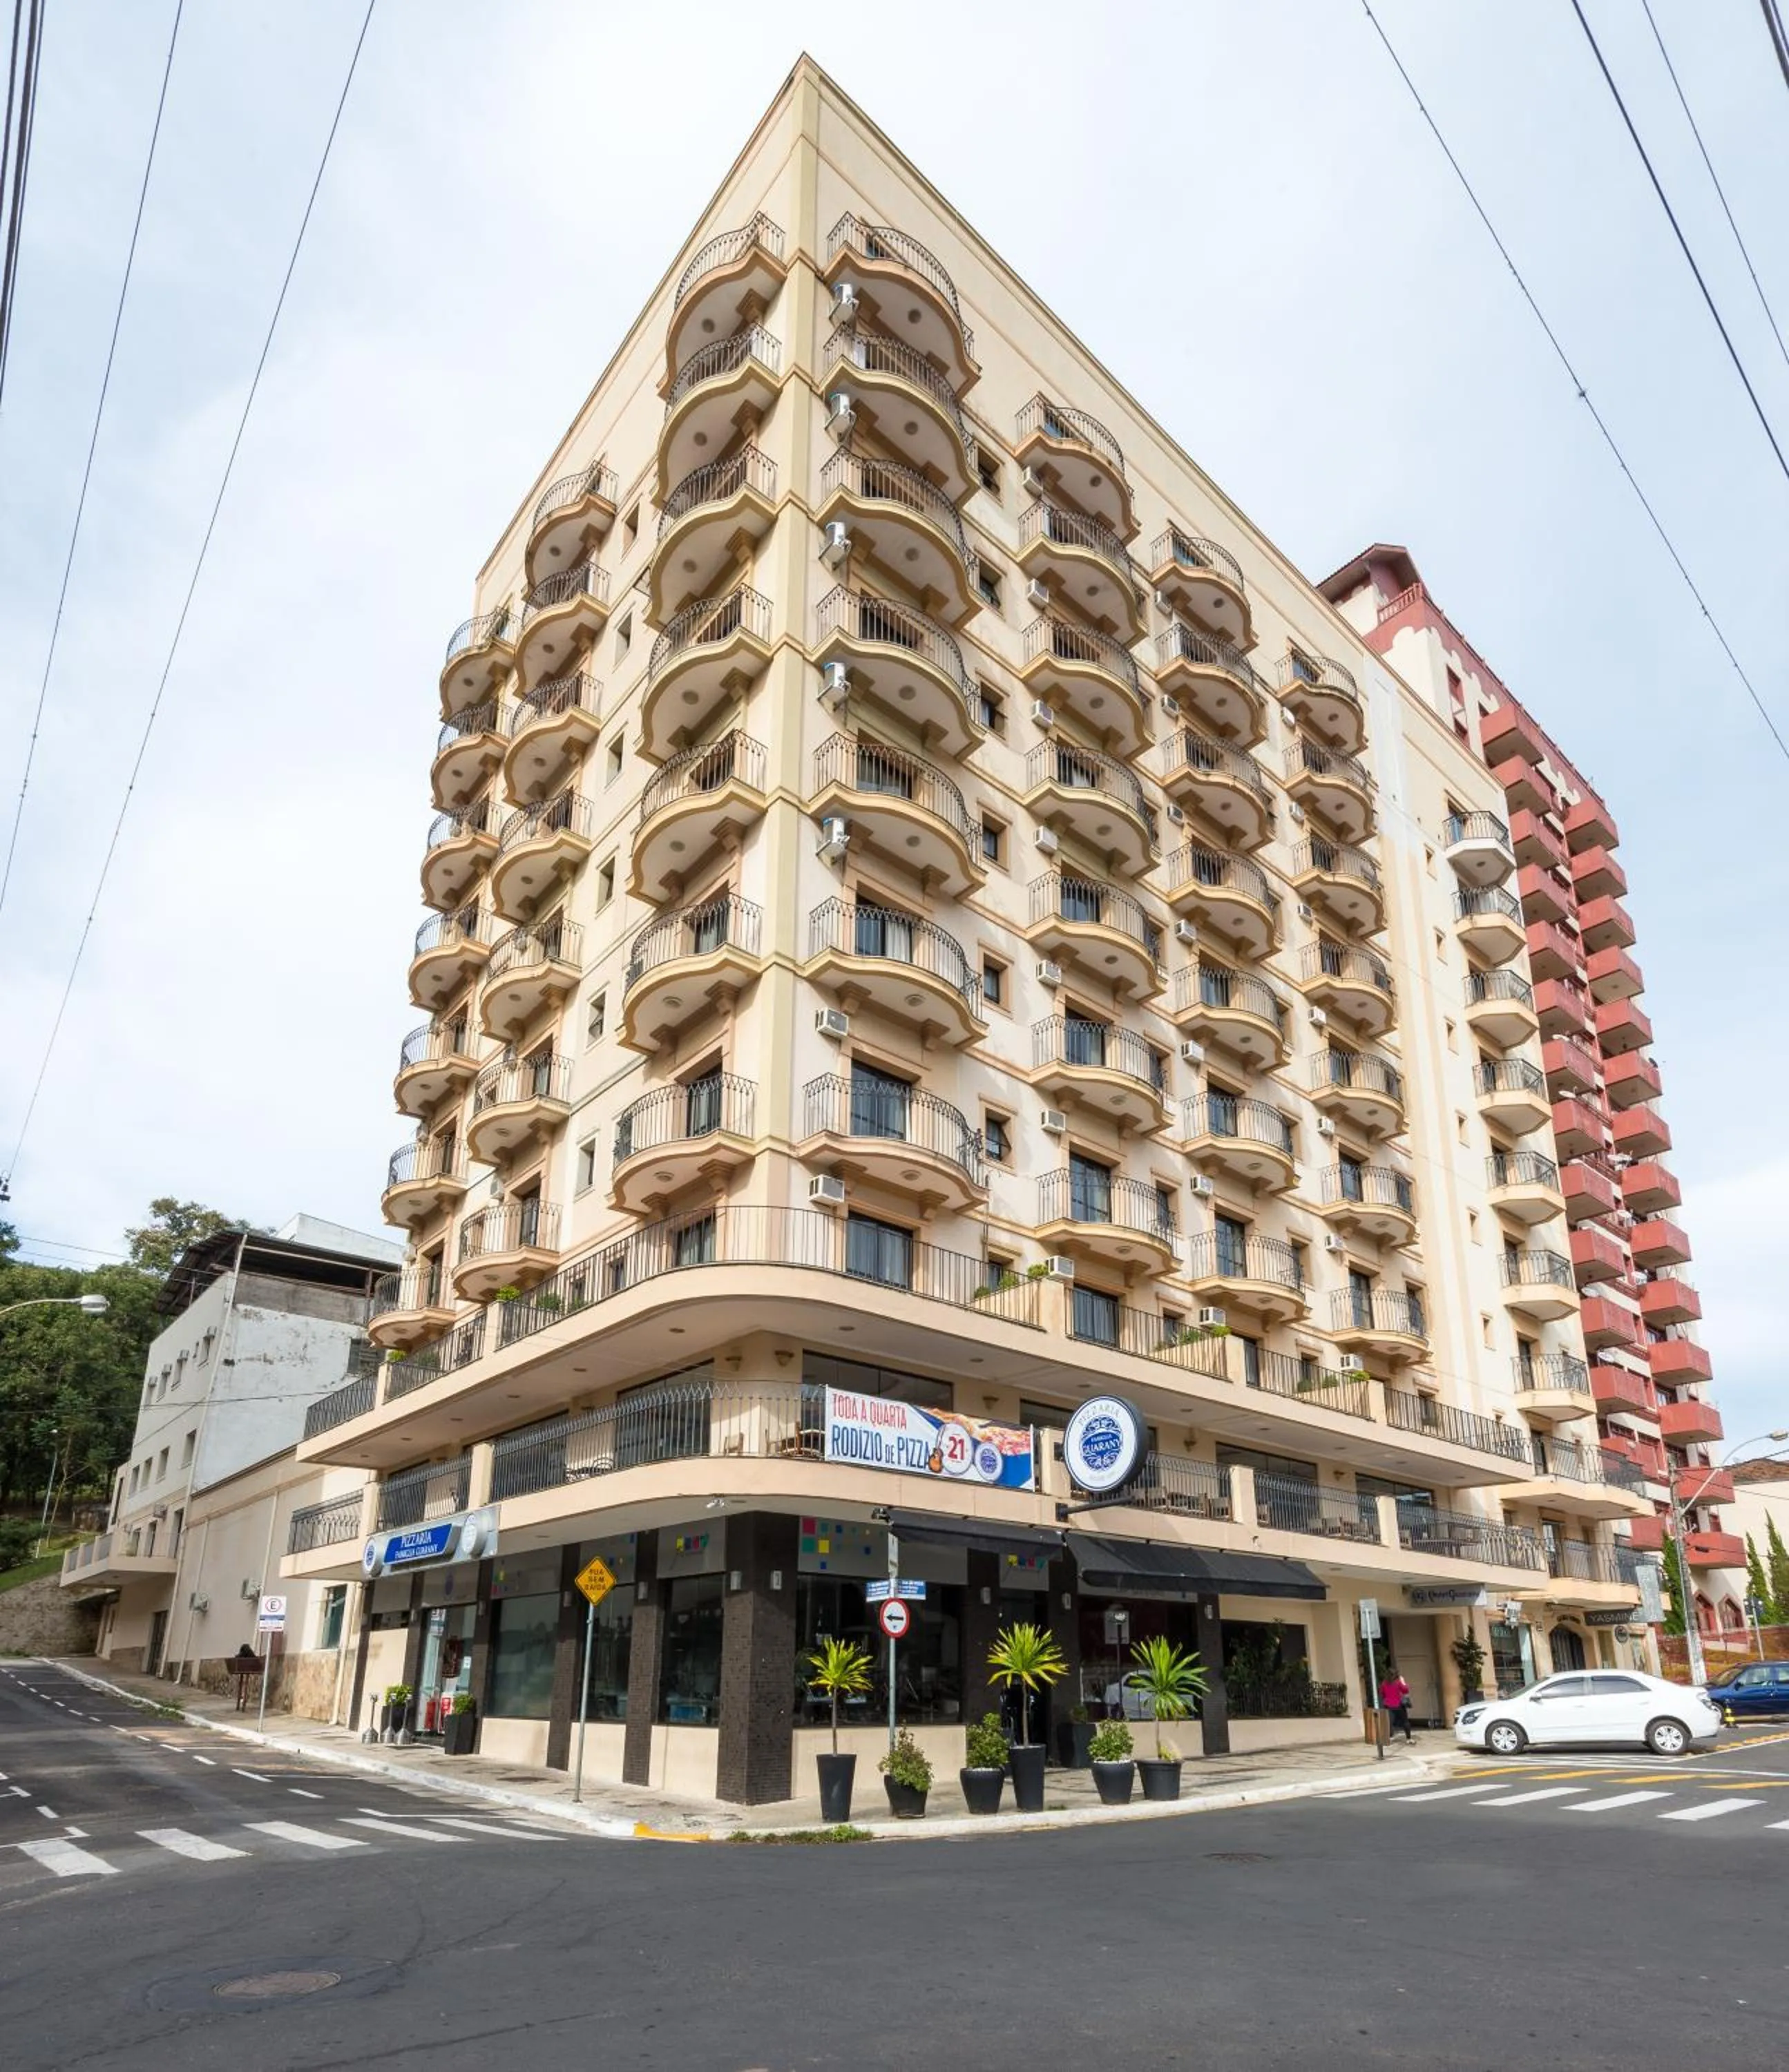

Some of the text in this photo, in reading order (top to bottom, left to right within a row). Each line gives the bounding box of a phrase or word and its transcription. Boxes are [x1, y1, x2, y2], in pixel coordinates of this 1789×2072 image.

[832, 1393, 907, 1430] TODA A QUARTA
[832, 1423, 930, 1469] RODÍZIO DE PIZZA
[948, 1436, 965, 1460] 21
[401, 1531, 432, 1548] PIZZARIA
[270, 1600, 277, 1610] E
[1589, 1611, 1639, 1623] YASMINE
